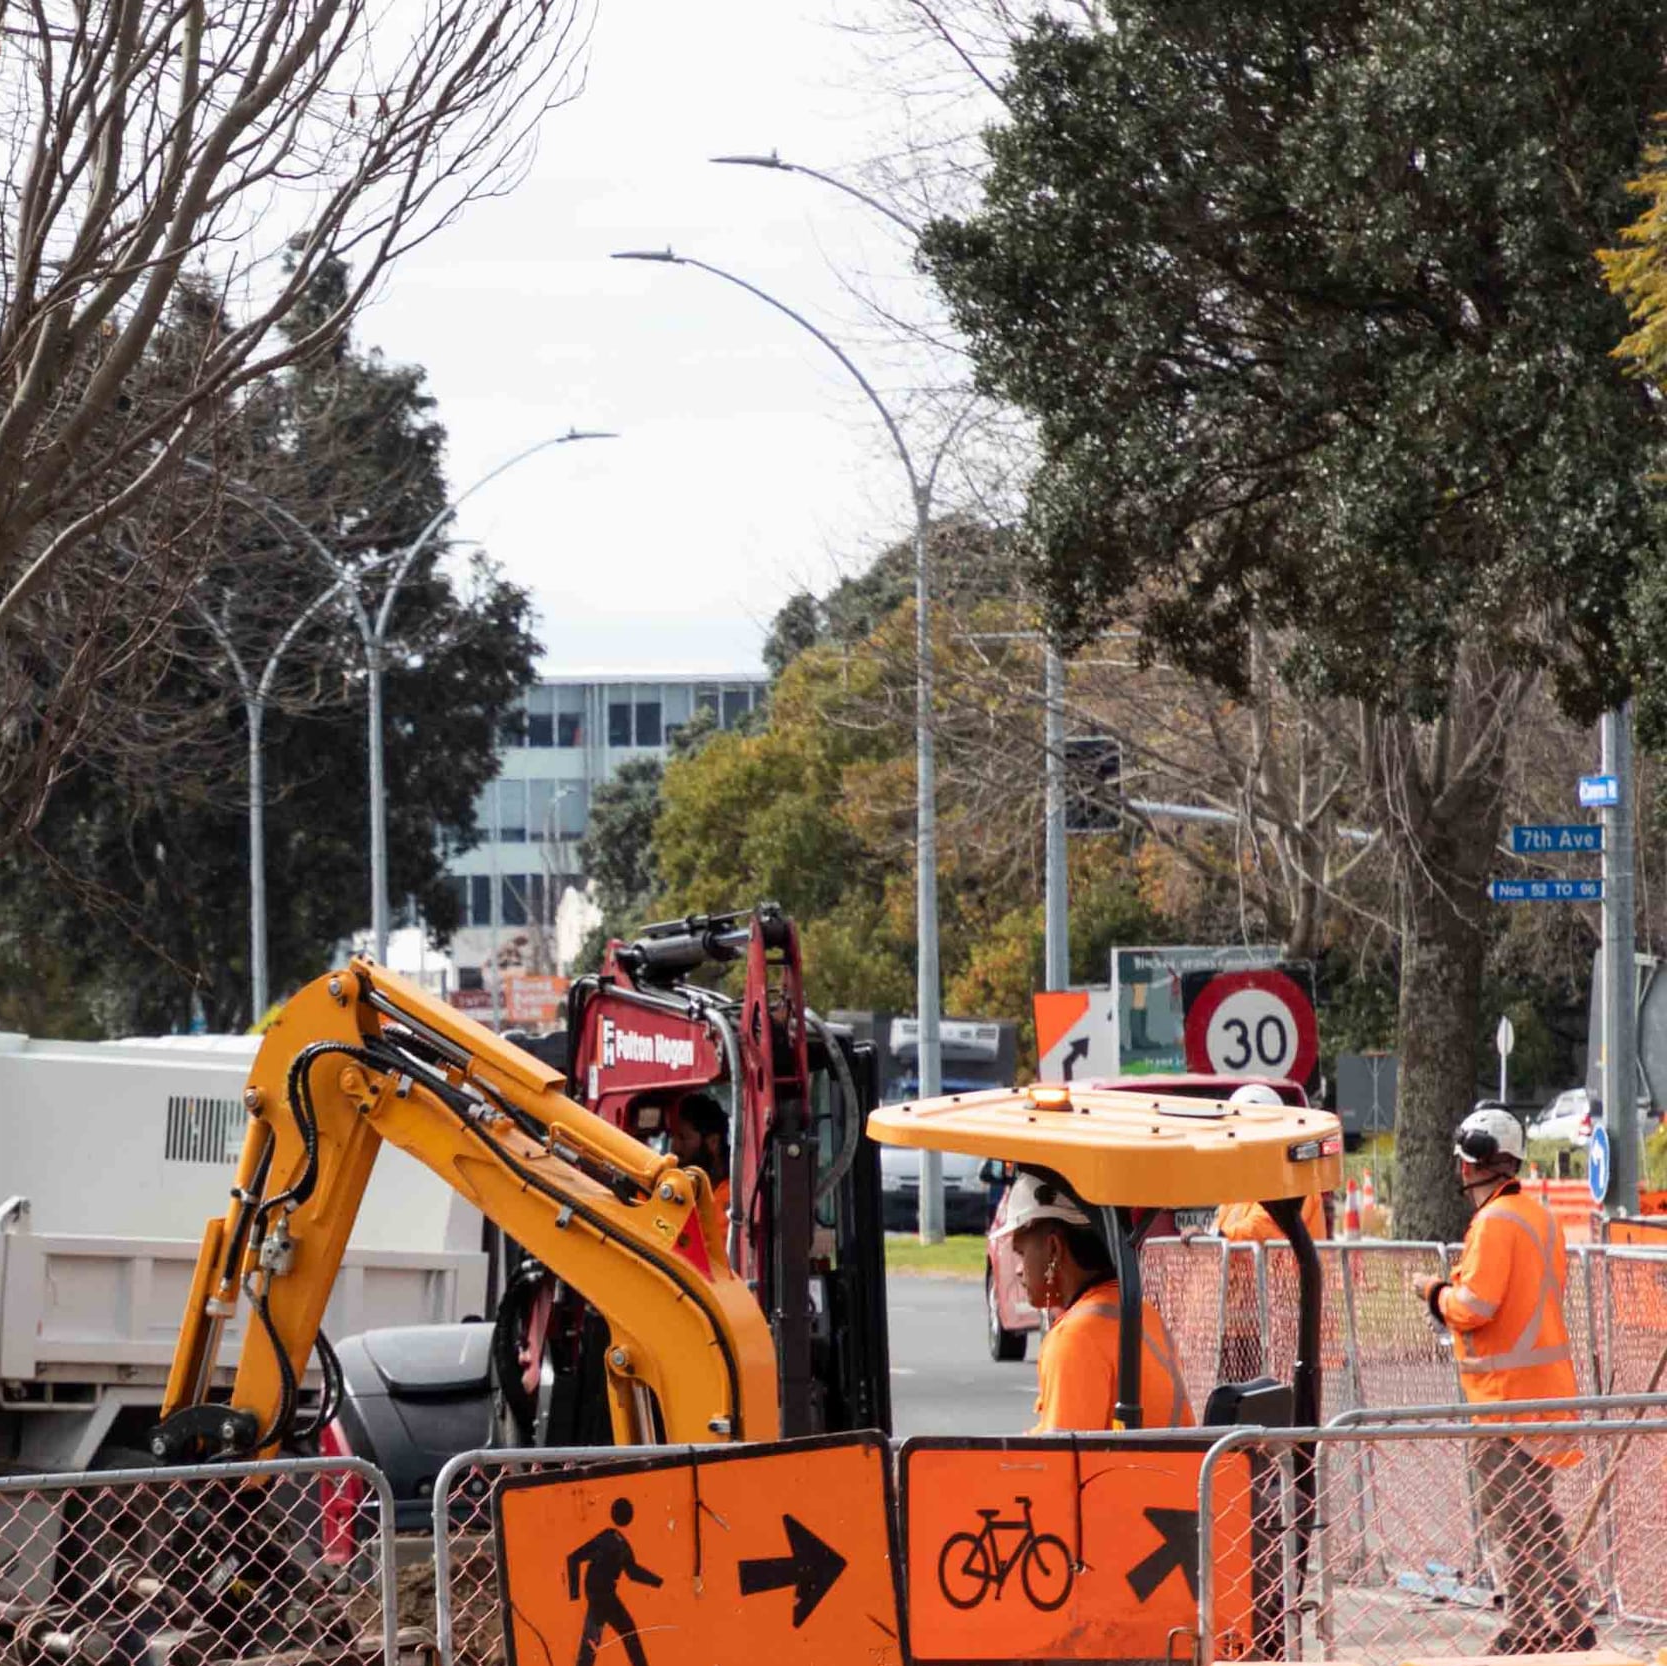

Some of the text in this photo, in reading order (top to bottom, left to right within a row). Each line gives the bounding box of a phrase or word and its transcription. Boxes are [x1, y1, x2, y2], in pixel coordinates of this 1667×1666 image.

[1521, 830, 1594, 847] 7th Ave
[1499, 884, 1524, 897] Nos
[1554, 884, 1572, 896] TO
[616, 1029, 694, 1070] Fulton Hogan
[1222, 1015, 1288, 1070] 30
